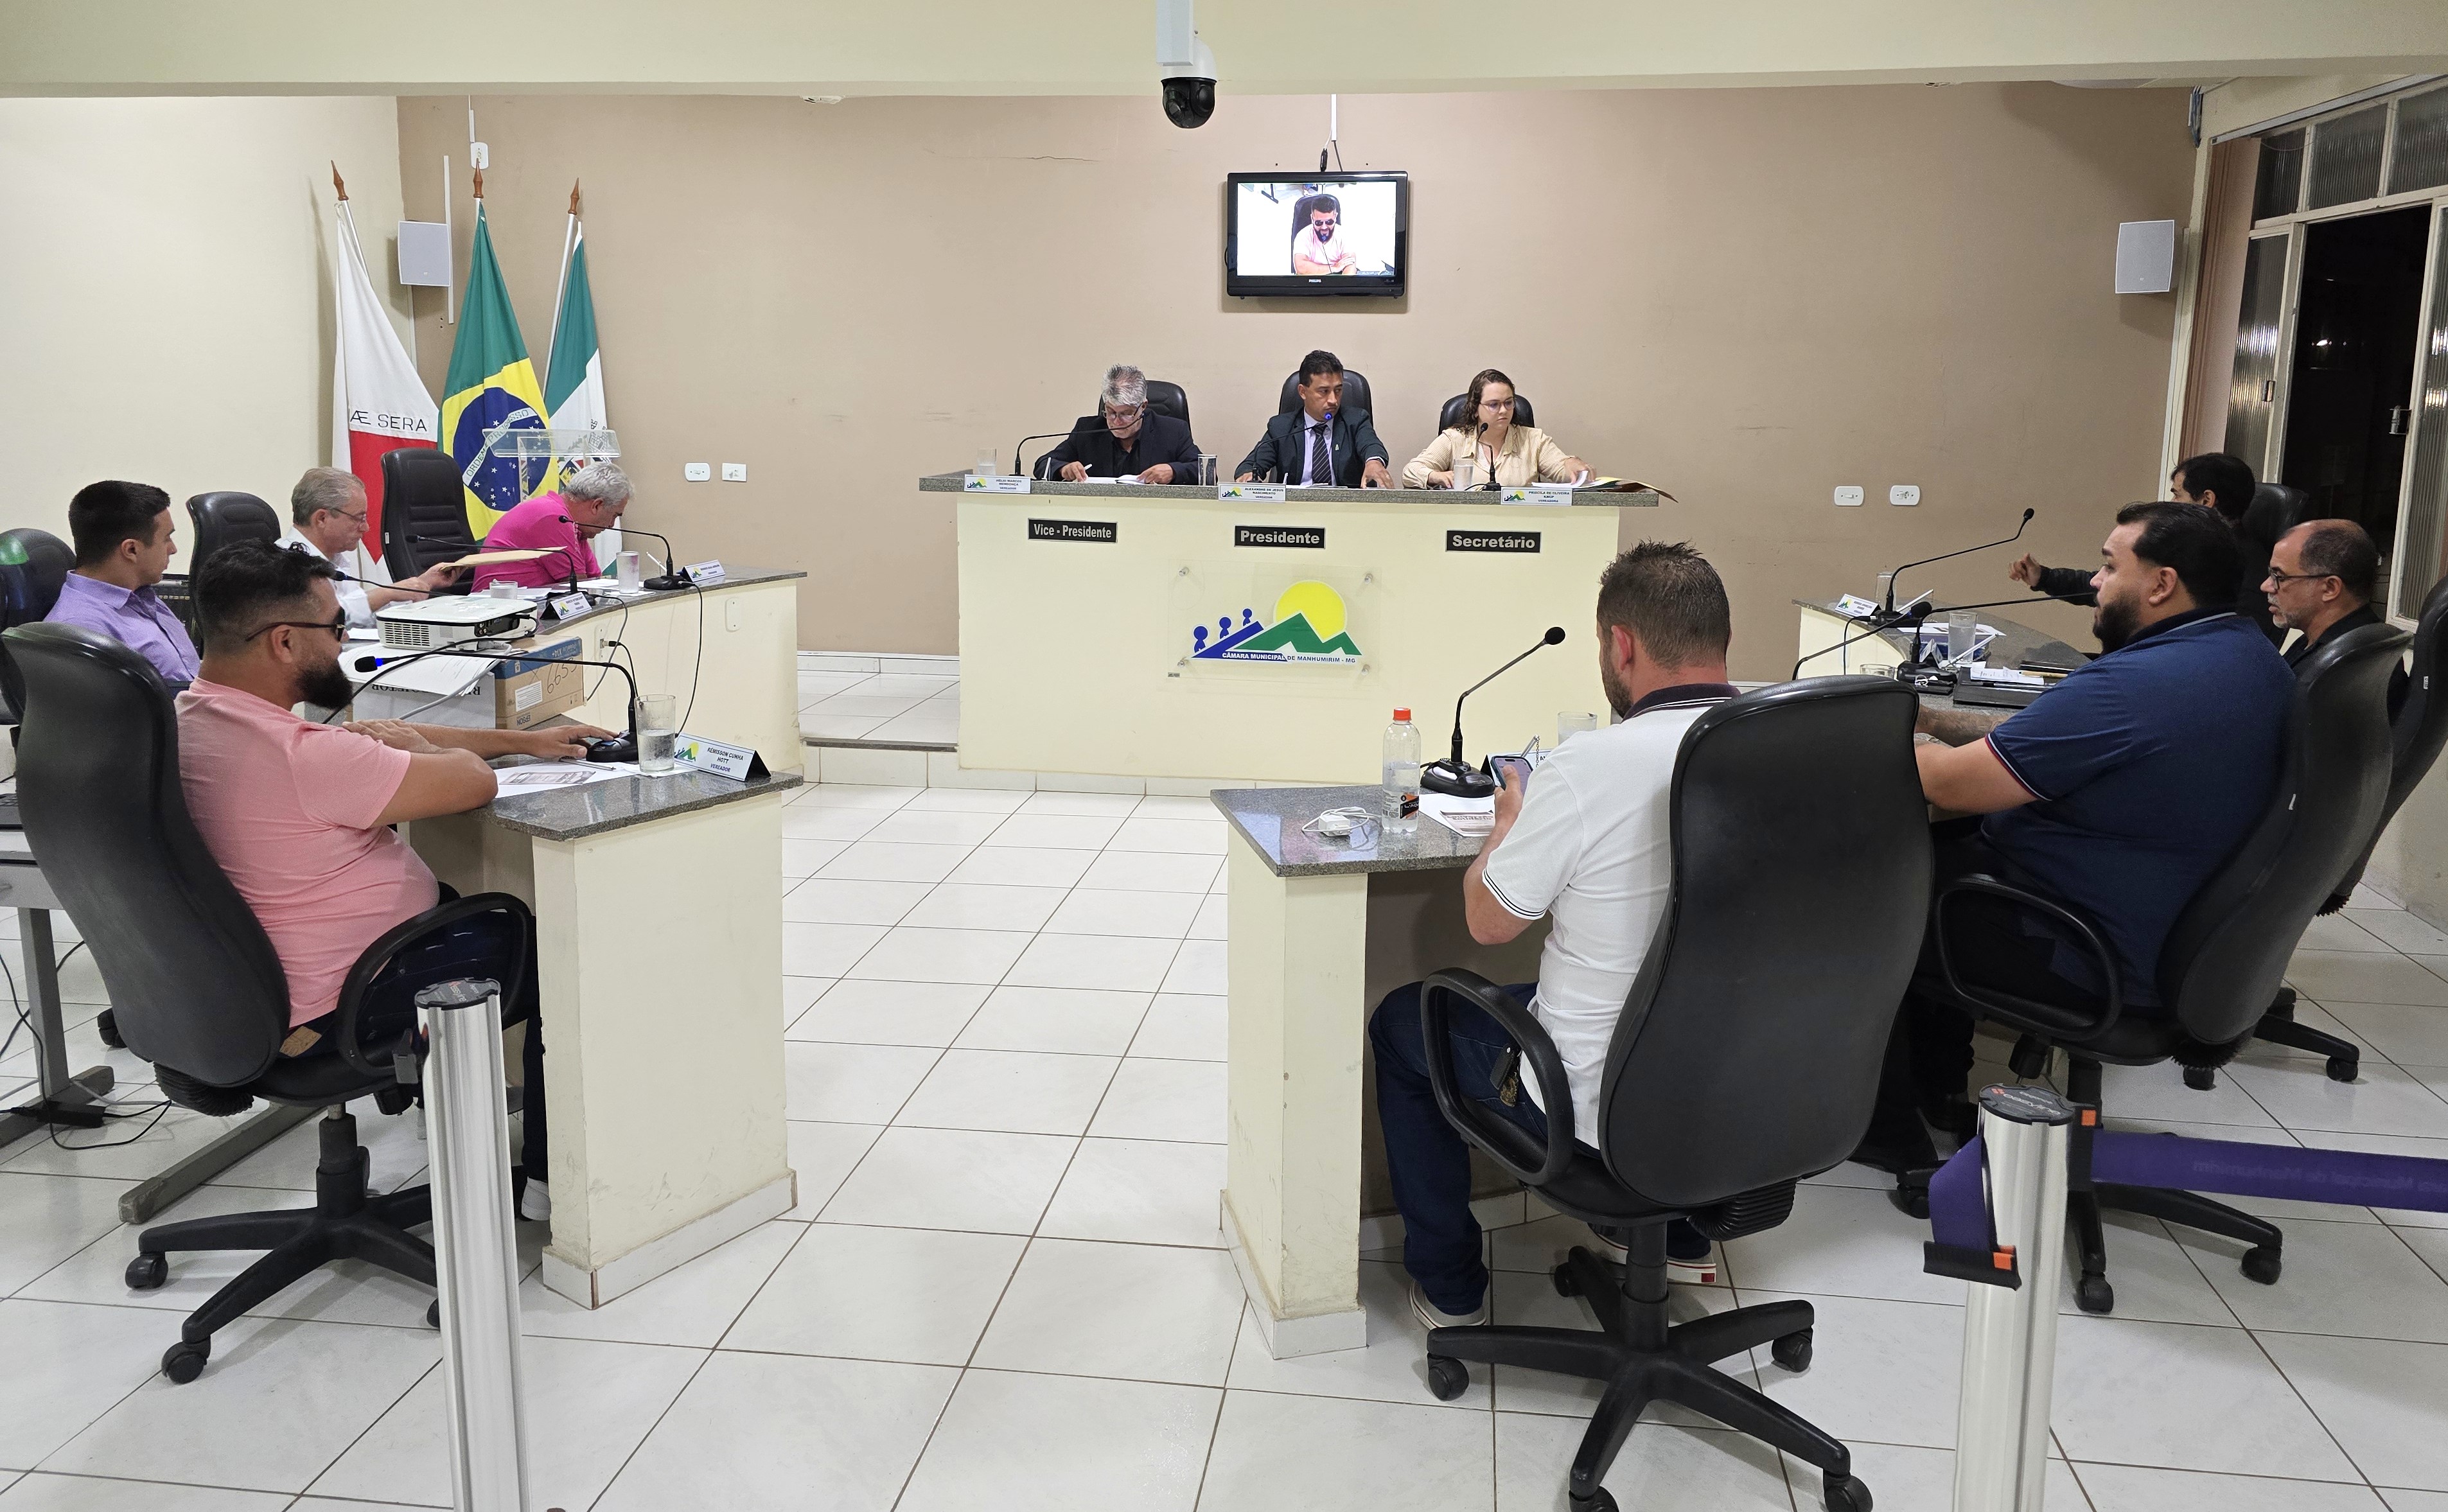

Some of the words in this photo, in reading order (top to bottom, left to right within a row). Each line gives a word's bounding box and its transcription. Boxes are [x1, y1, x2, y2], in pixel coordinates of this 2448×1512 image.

[378, 414, 427, 432] SERA
[1034, 523, 1055, 536] Vice
[1062, 525, 1112, 538] Presidente
[1240, 530, 1320, 544] Presidente
[1452, 534, 1535, 549] Secretário
[710, 763, 731, 773] VEREADOR
